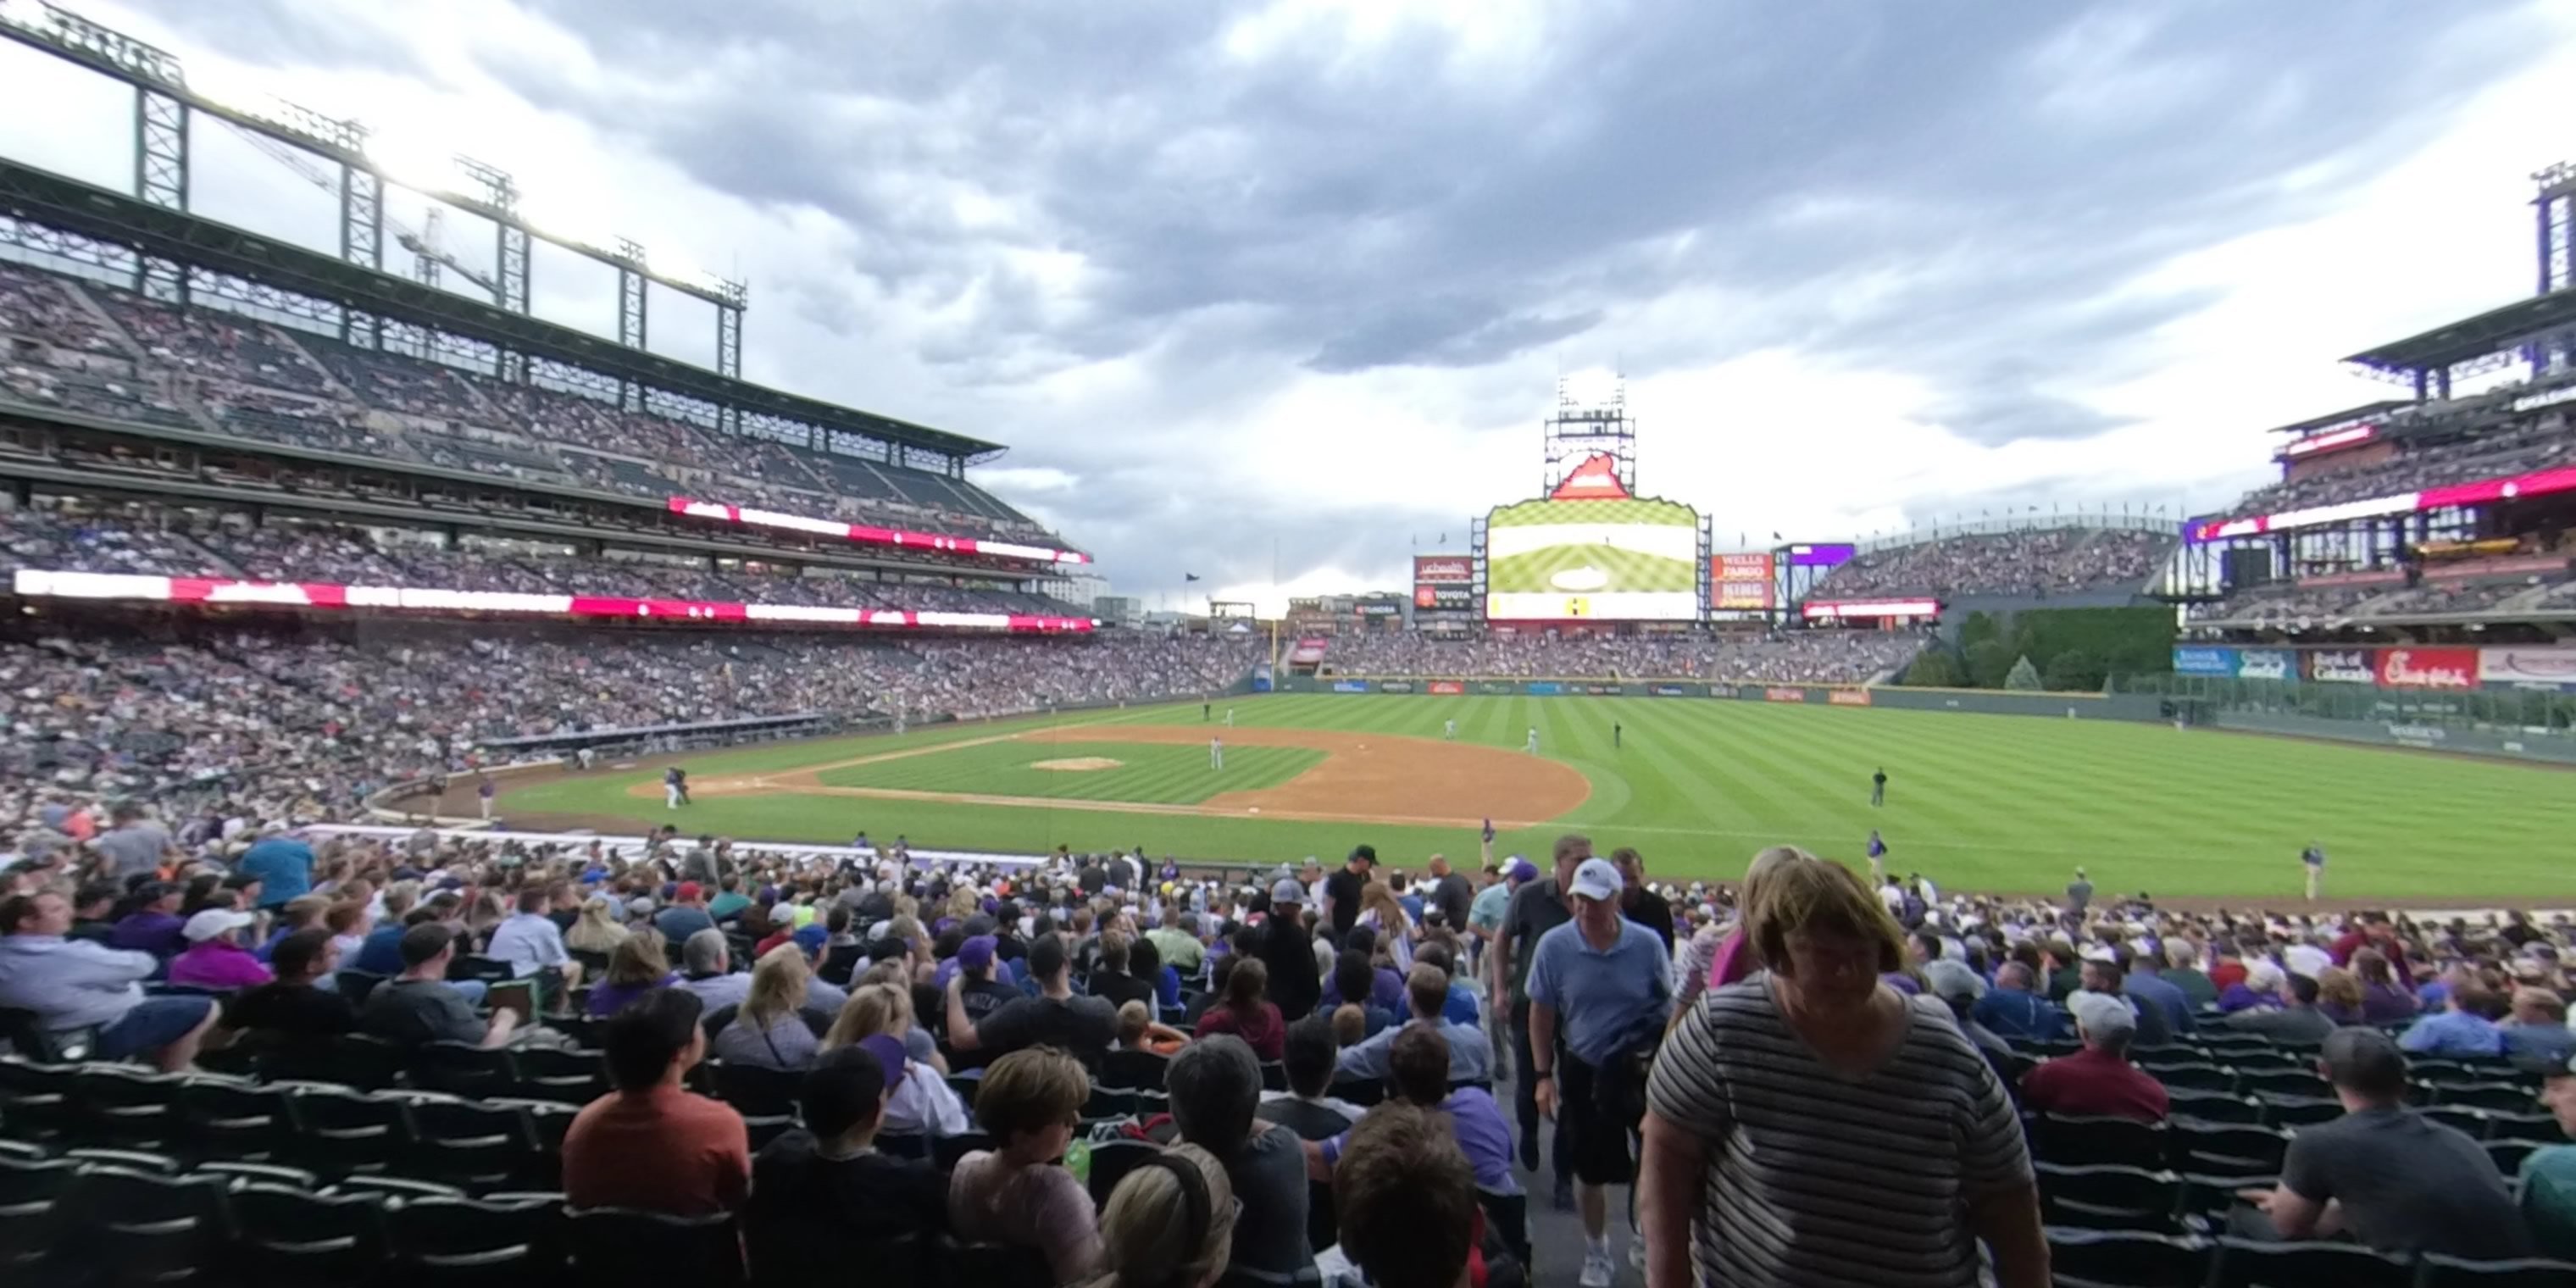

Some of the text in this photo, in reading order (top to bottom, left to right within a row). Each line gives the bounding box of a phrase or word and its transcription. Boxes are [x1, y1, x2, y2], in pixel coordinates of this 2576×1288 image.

[1721, 555, 1764, 565] WELLS
[1723, 566, 1765, 576] FARGO
[1435, 590, 1470, 599] TOYOTA
